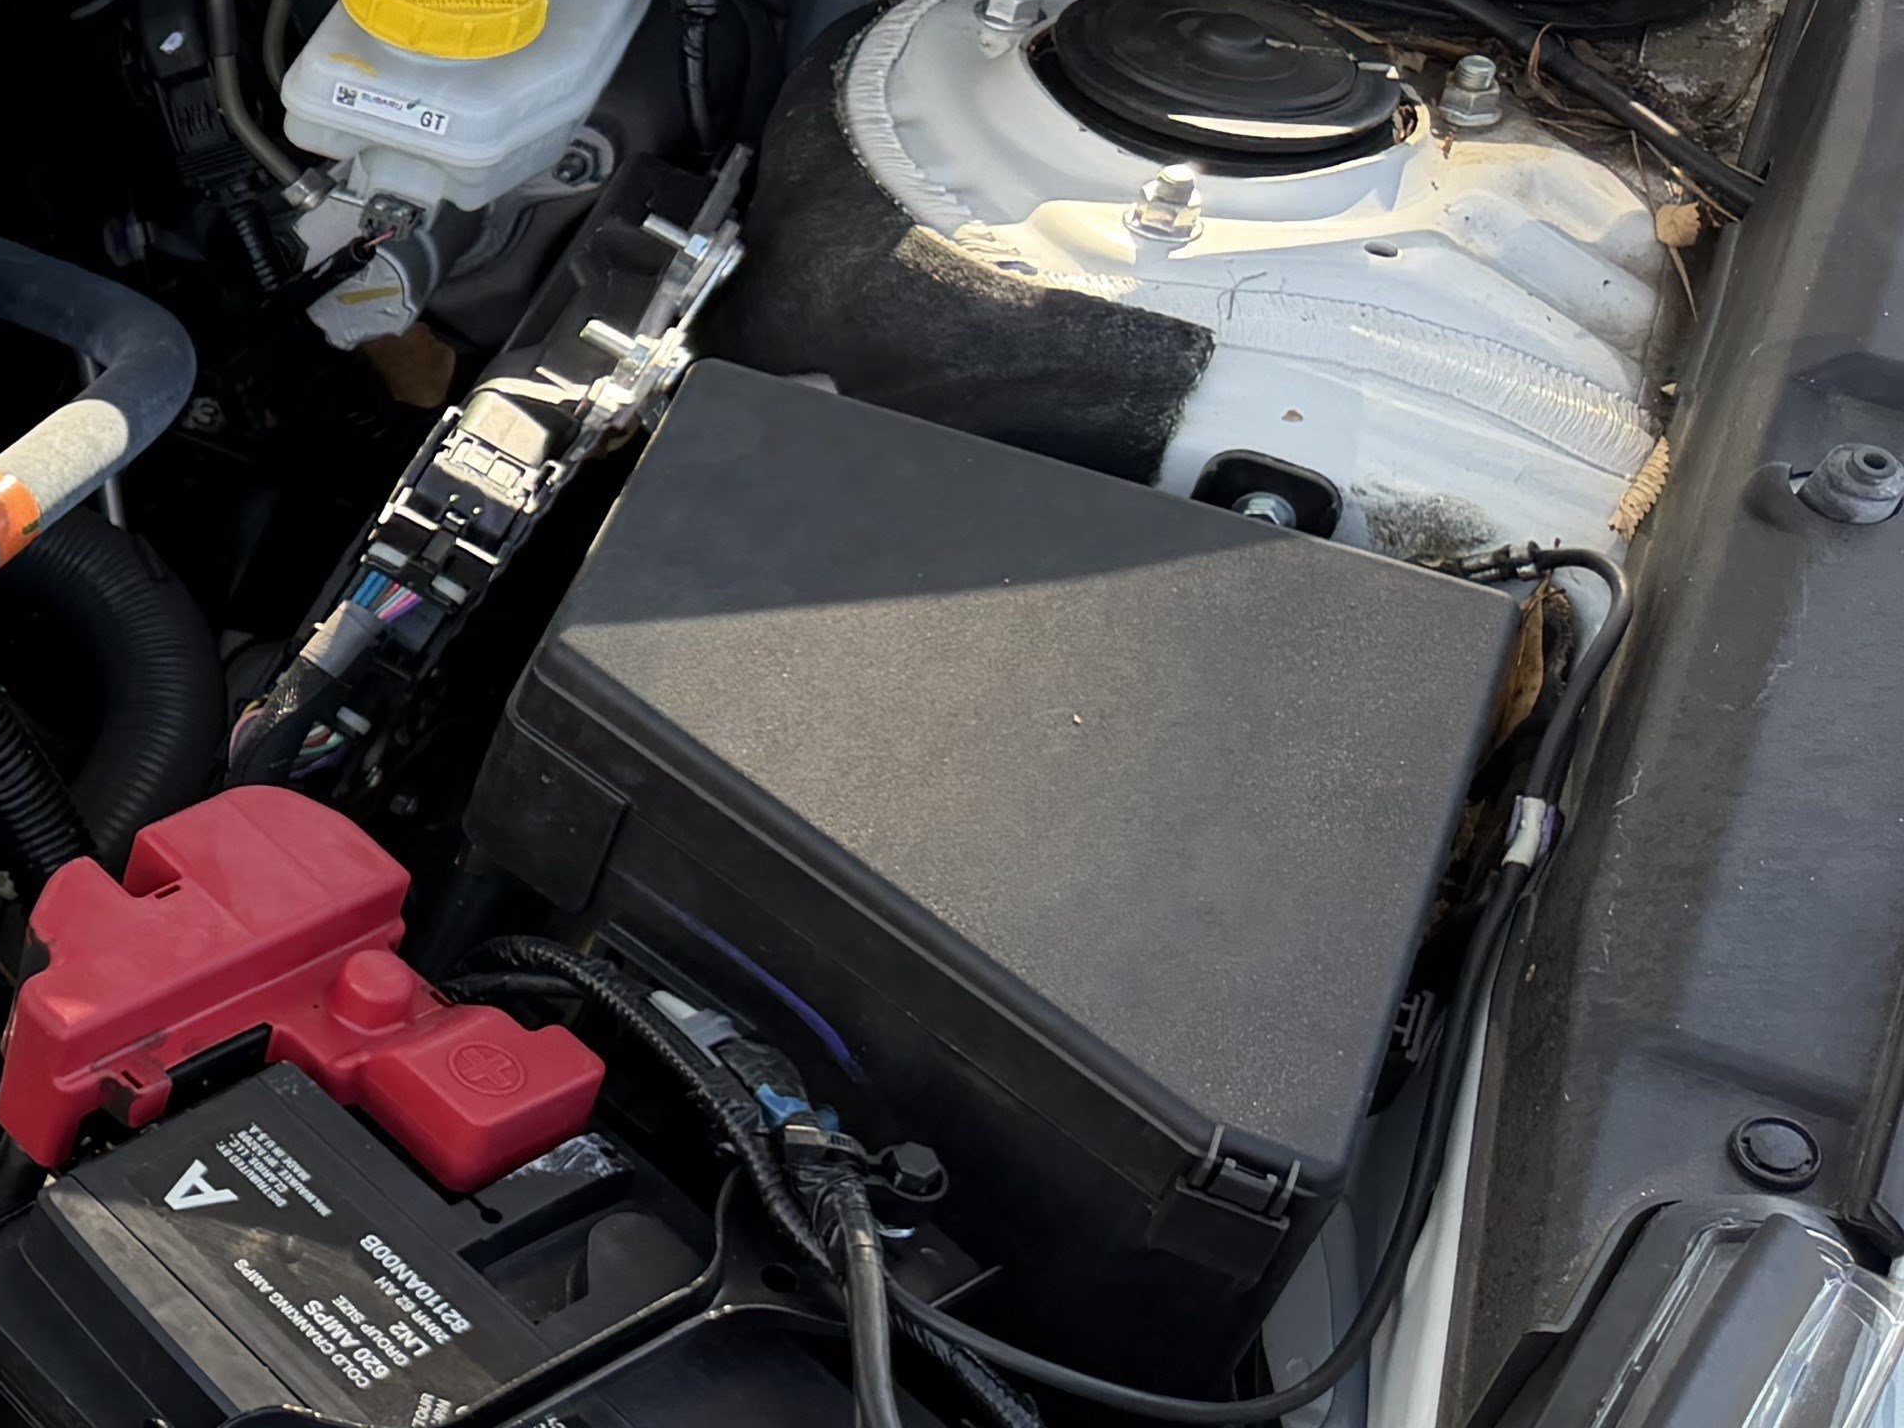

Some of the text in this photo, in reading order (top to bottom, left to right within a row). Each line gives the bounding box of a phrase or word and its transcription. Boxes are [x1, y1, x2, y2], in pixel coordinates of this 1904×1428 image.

[420, 110, 445, 130] GT
[163, 1158, 239, 1211] A
[213, 1139, 288, 1208] DISTRIBUTED BY:
[245, 1121, 312, 1182] MADE IN U.S.A.
[356, 1230, 473, 1336] 82110AN00B
[372, 1273, 452, 1346] 20HR 62 AH
[231, 1256, 373, 1389] COLD CRANKING AMPS
[300, 1297, 393, 1381] 620 AMPS
[330, 1293, 412, 1368] GROUP SIZE
[386, 1319, 432, 1358] LN2
[411, 1392, 434, 1427] TOUR
